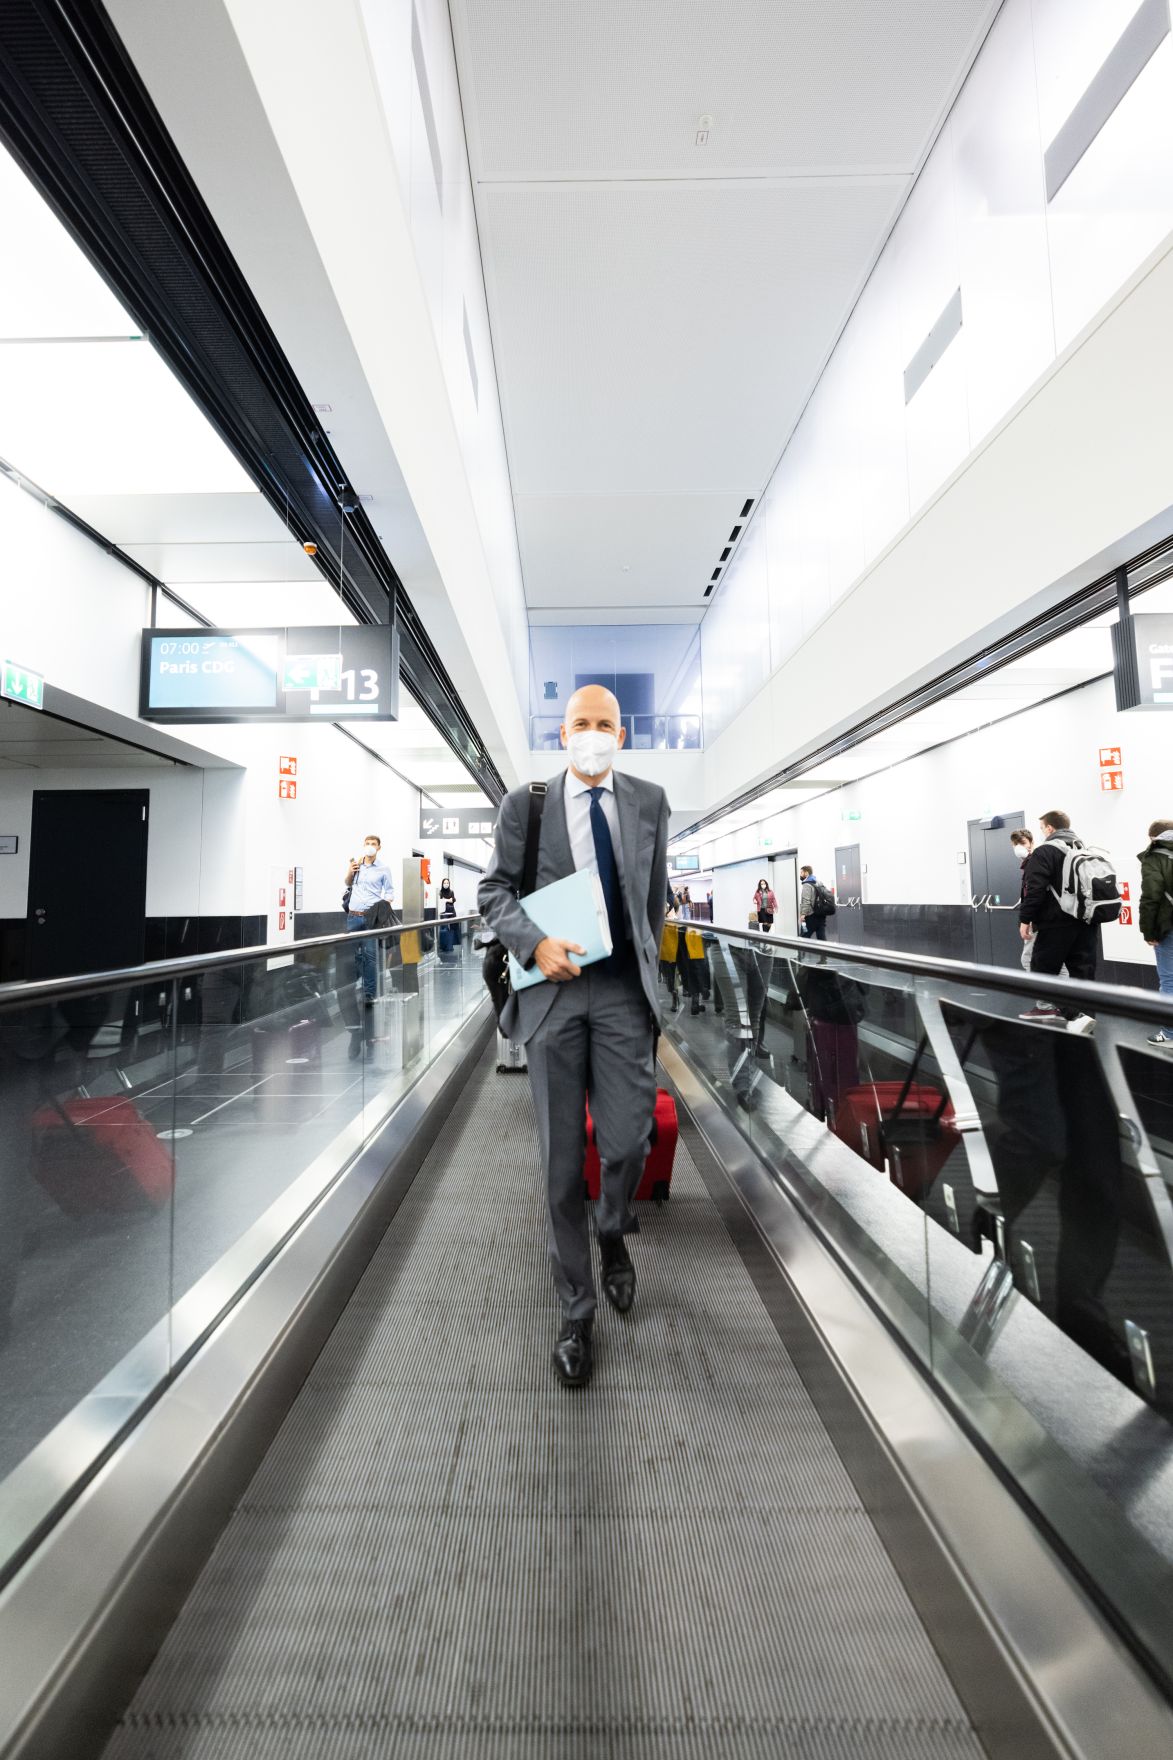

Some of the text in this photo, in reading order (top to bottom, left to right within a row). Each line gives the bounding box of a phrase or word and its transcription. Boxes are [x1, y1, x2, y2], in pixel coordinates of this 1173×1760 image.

[160, 642, 199, 655] 07:00
[160, 660, 235, 674] Paris CDG
